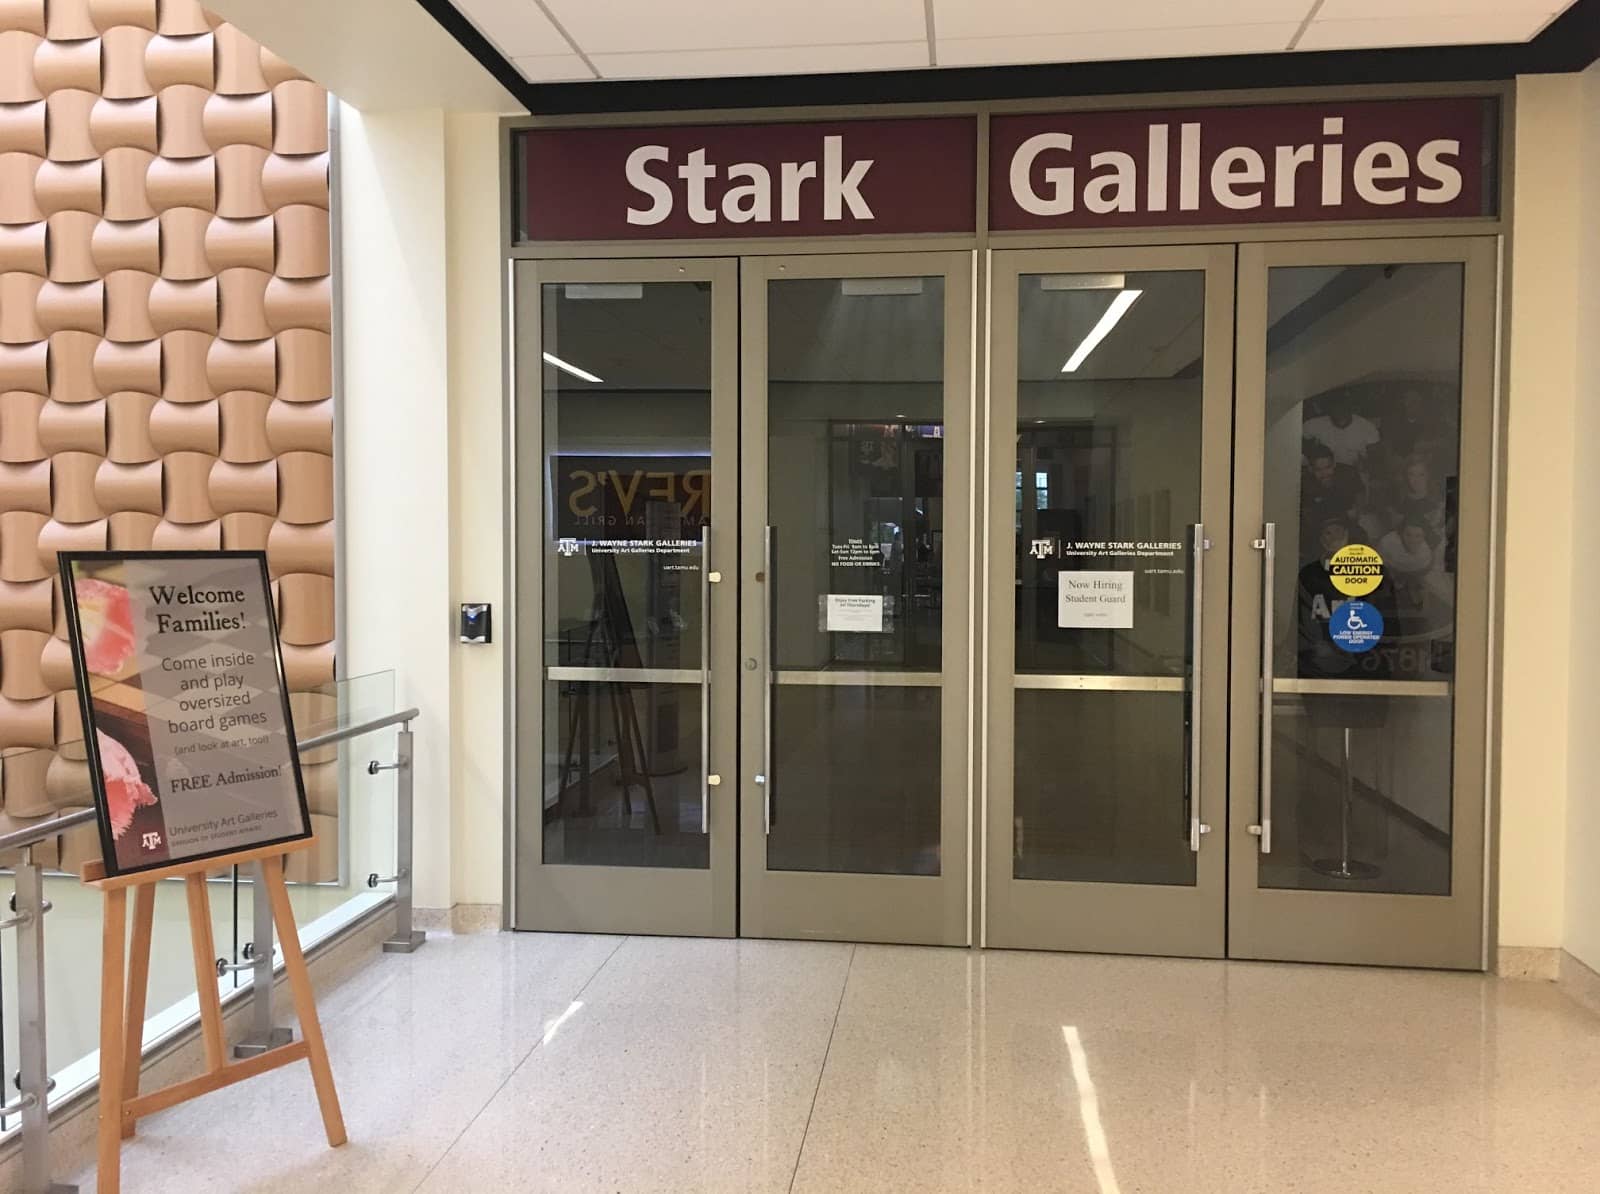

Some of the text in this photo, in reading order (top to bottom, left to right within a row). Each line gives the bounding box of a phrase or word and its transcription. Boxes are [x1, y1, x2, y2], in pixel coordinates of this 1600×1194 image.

[625, 117, 1463, 226] Stark Galleries
[1066, 542, 1182, 550] J. WAYNE STARK GALLERIES
[1333, 566, 1380, 575] CAUTION
[1335, 556, 1379, 564] AUTOMATIC
[150, 584, 246, 606] Welcome
[1068, 580, 1123, 592] Now Hiring
[1065, 594, 1126, 603] Student Guard
[156, 612, 247, 634] Families!
[161, 651, 255, 672] Come inside
[180, 672, 245, 694] and play
[179, 690, 251, 712] oversized
[168, 711, 267, 734] board games
[174, 744, 196, 755] (and
[199, 742, 218, 752] look
[171, 765, 282, 793] FREE Admission!
[169, 810, 279, 837] University Art Galleries
